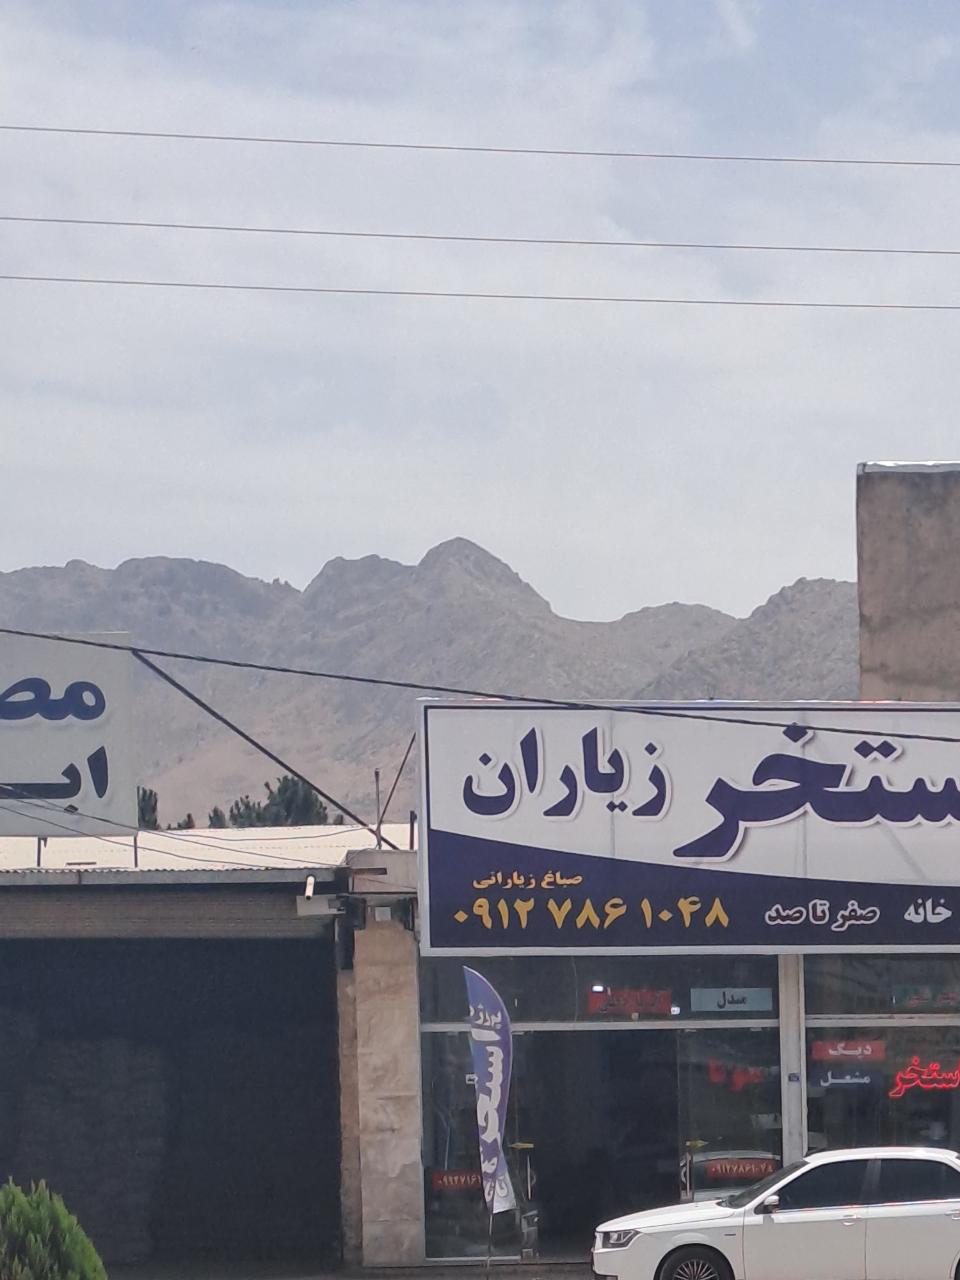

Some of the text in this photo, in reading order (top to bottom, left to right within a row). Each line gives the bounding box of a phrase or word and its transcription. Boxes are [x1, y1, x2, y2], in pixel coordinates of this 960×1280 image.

[0, 677, 106, 721] مص
[462, 726, 668, 817] زیاران
[472, 870, 583, 889] صباغ زیارانی
[453, 896, 731, 929] ۰۹۱۲ ۷۸۶ ۱۰۴۸
[764, 898, 881, 931] صفر تا صد
[903, 898, 953, 924] خانه
